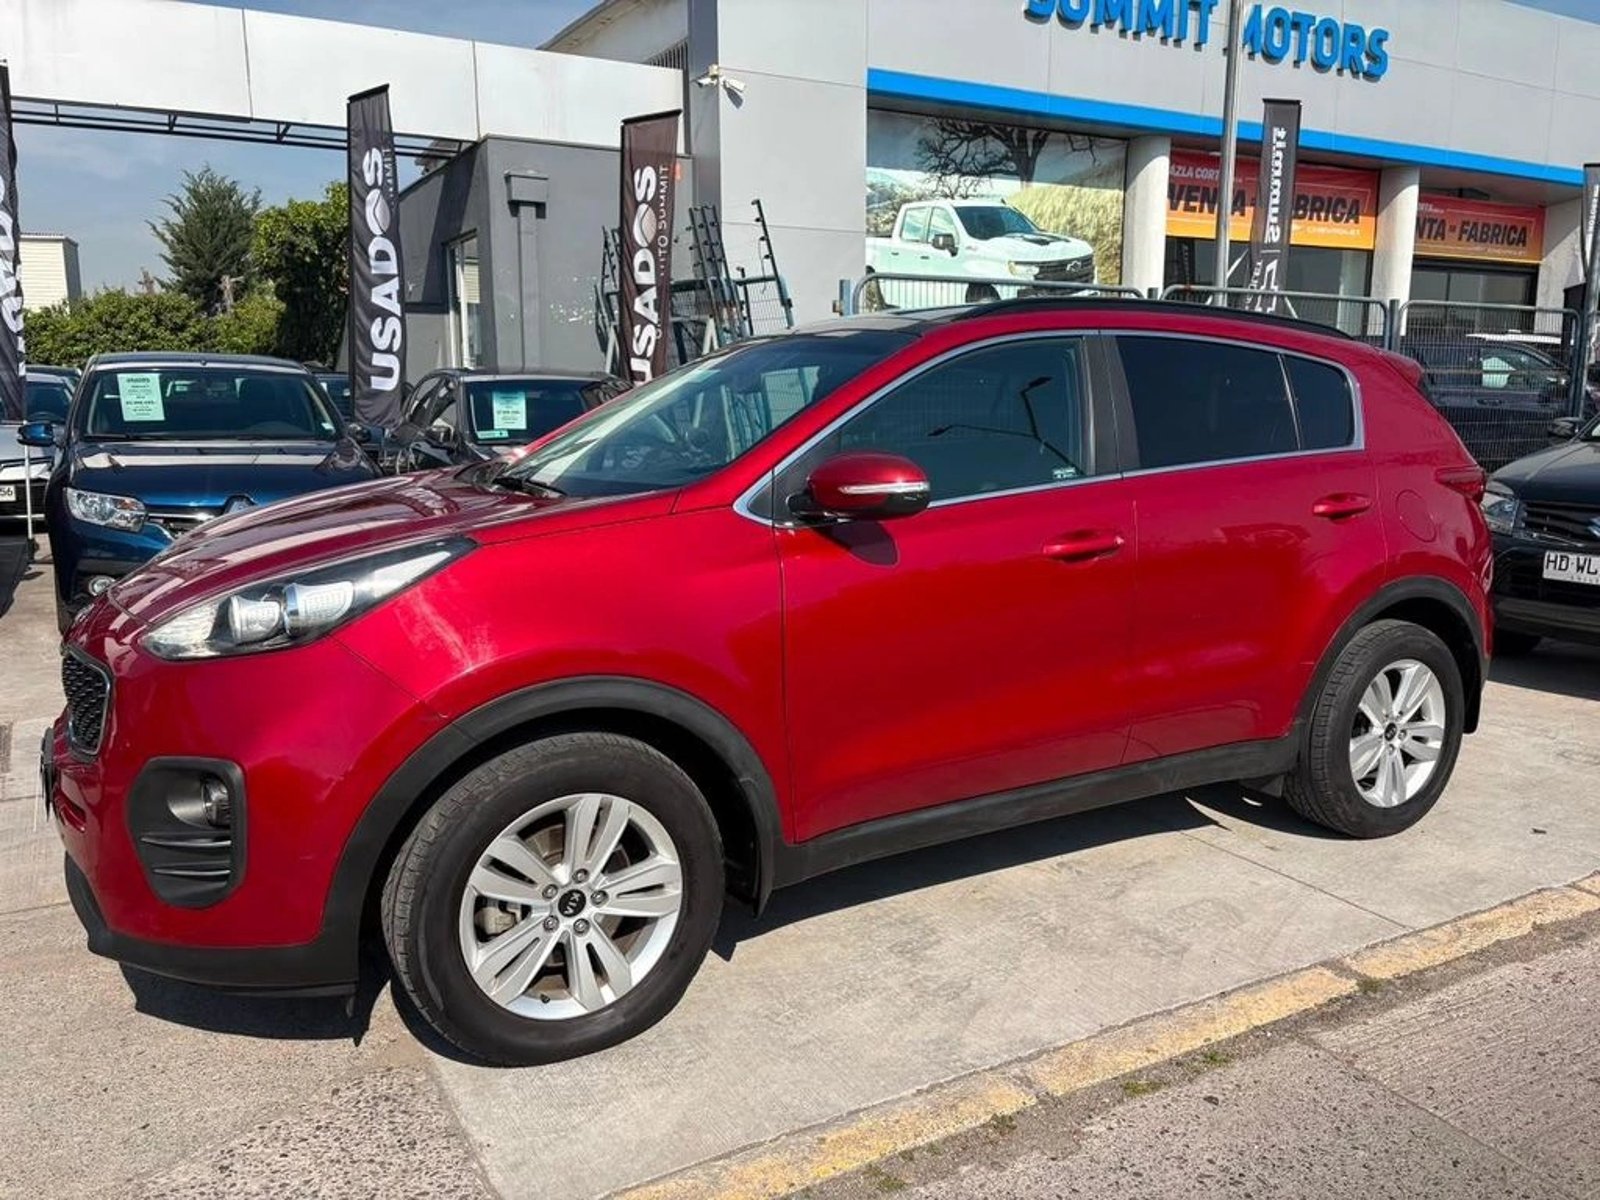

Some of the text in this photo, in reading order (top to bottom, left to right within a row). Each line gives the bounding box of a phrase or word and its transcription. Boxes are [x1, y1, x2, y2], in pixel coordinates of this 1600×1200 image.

[1169, 164, 1194, 178] AZLA
[1167, 182, 1360, 225] VENA BRICA
[1416, 216, 1446, 240] NTA
[362, 147, 401, 392] USADOS
[630, 165, 659, 386] USADOS
